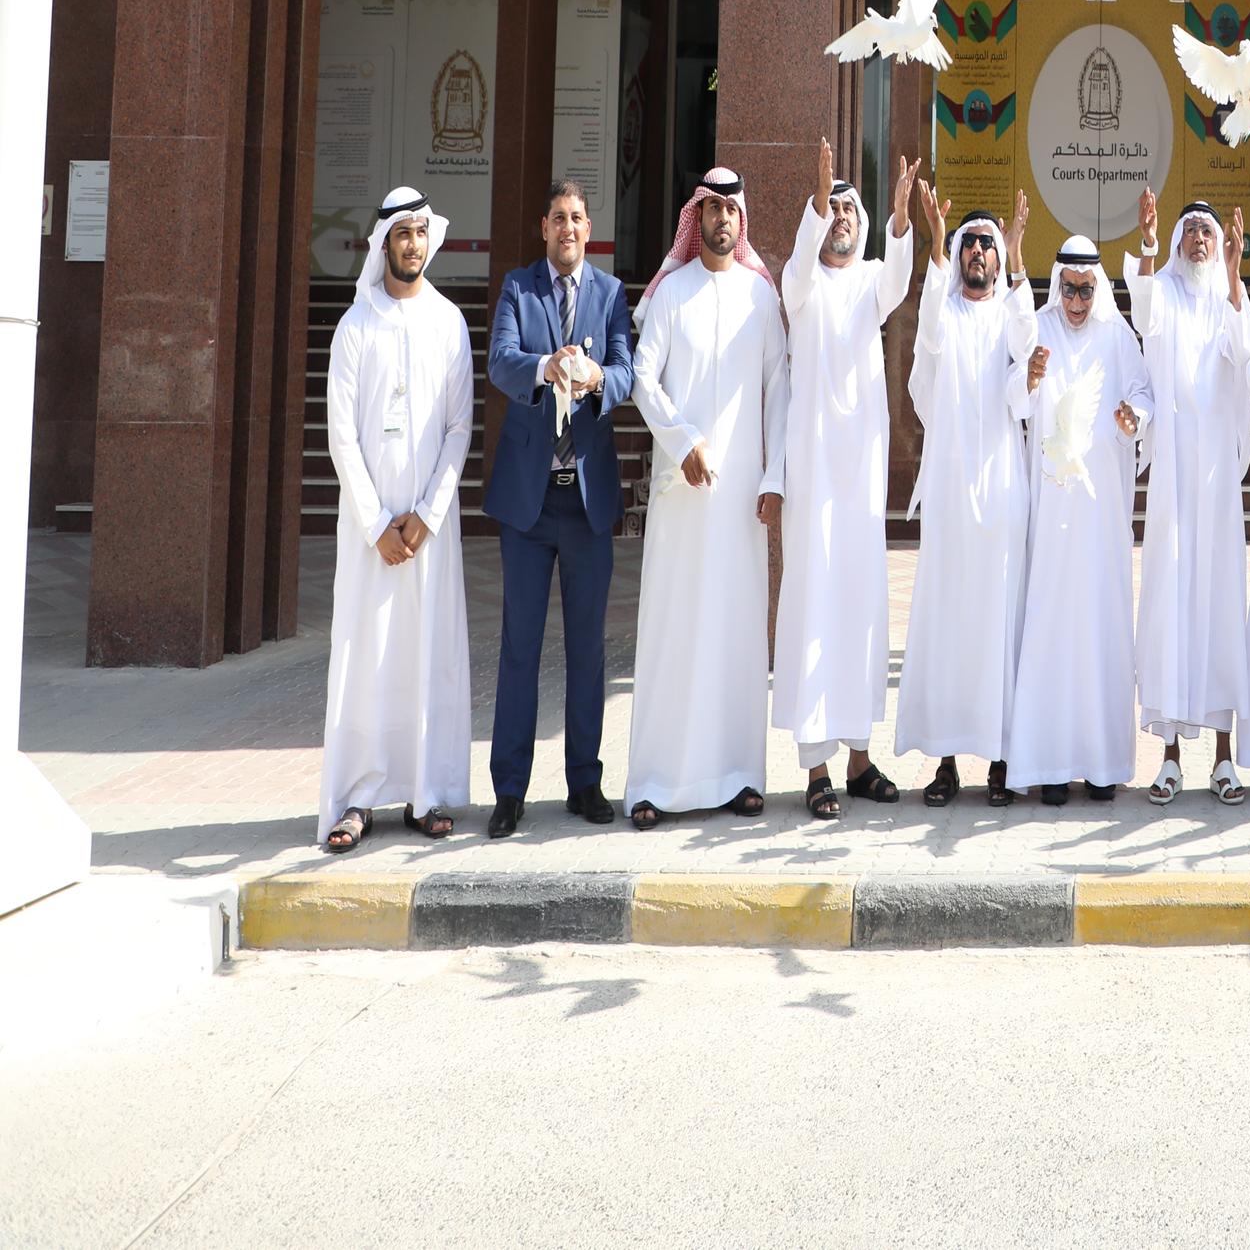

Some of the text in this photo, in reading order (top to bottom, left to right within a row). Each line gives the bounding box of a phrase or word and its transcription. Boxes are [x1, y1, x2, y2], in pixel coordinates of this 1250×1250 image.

[1052, 142, 1148, 160] دائرة المحاكم
[1052, 167, 1148, 185] Courts Department
